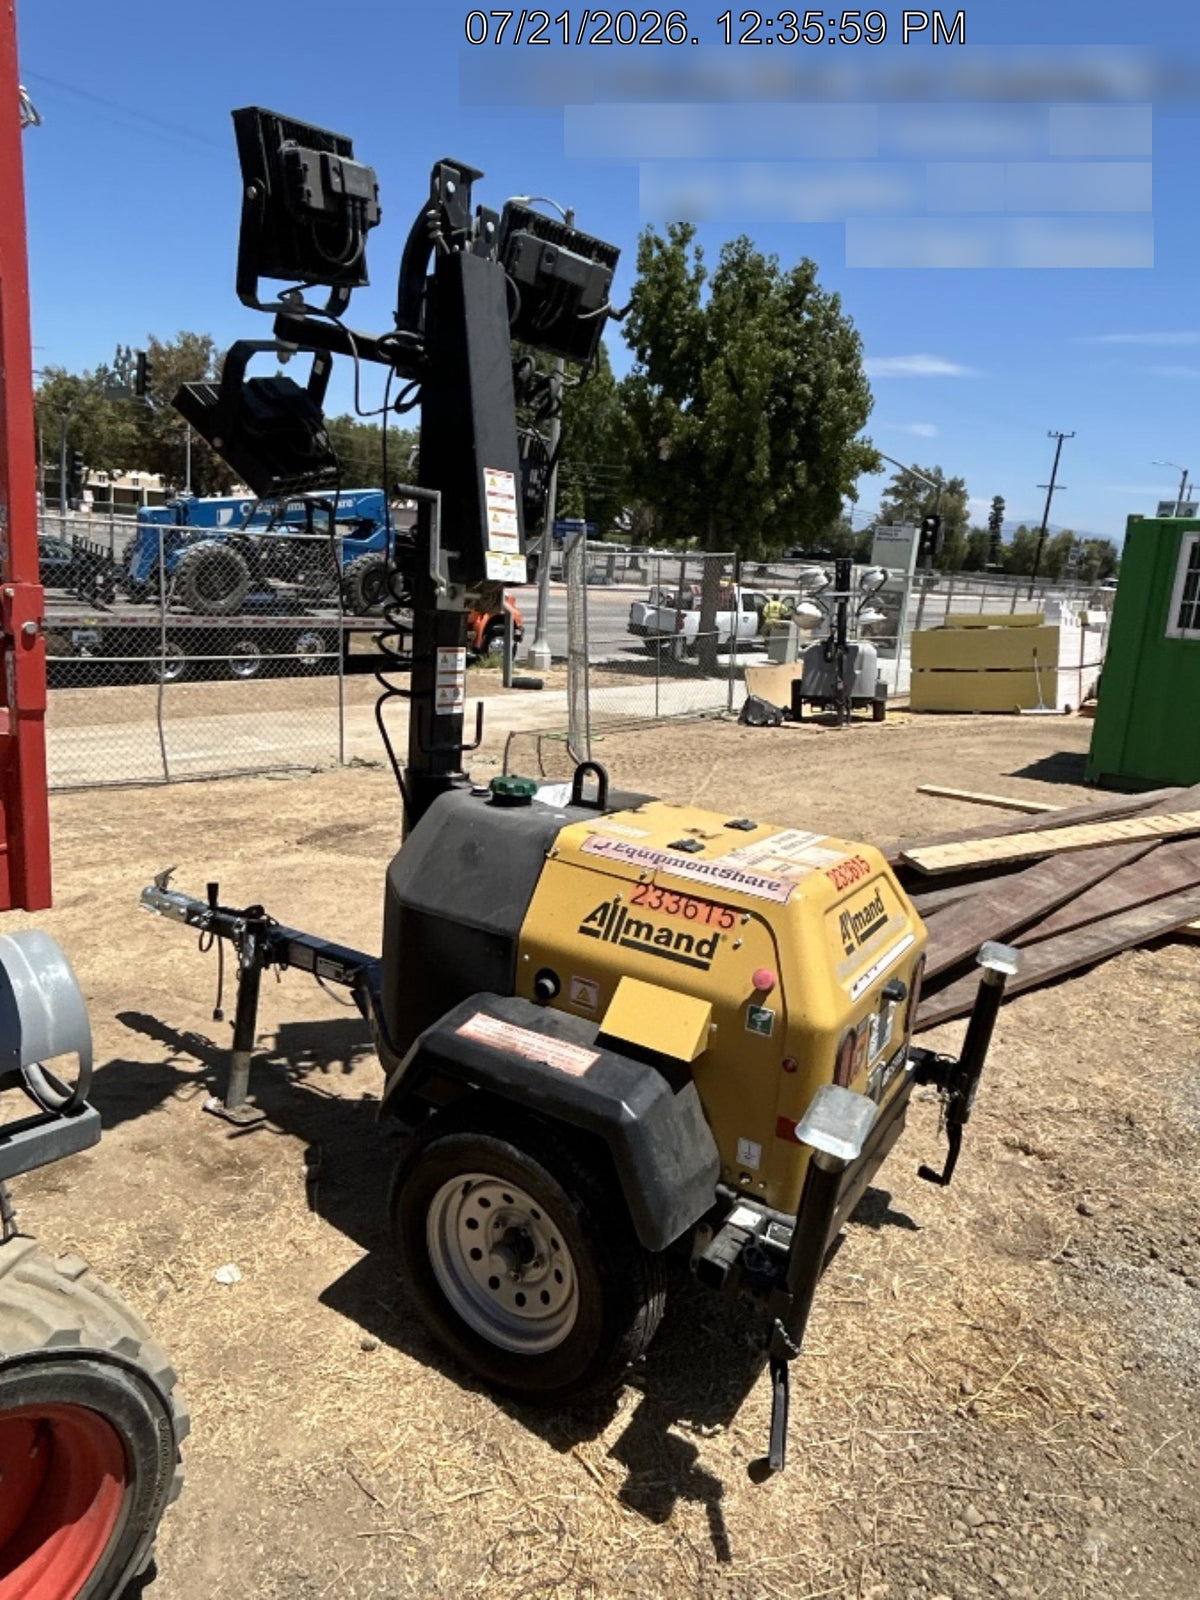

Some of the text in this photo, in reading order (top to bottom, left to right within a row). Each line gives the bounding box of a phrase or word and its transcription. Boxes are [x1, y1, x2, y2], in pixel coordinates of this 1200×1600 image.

[612, 841, 782, 892] EquipmentShare
[579, 901, 721, 968] Allmand
[630, 883, 735, 929] 233615
[838, 886, 888, 952] Allmand
